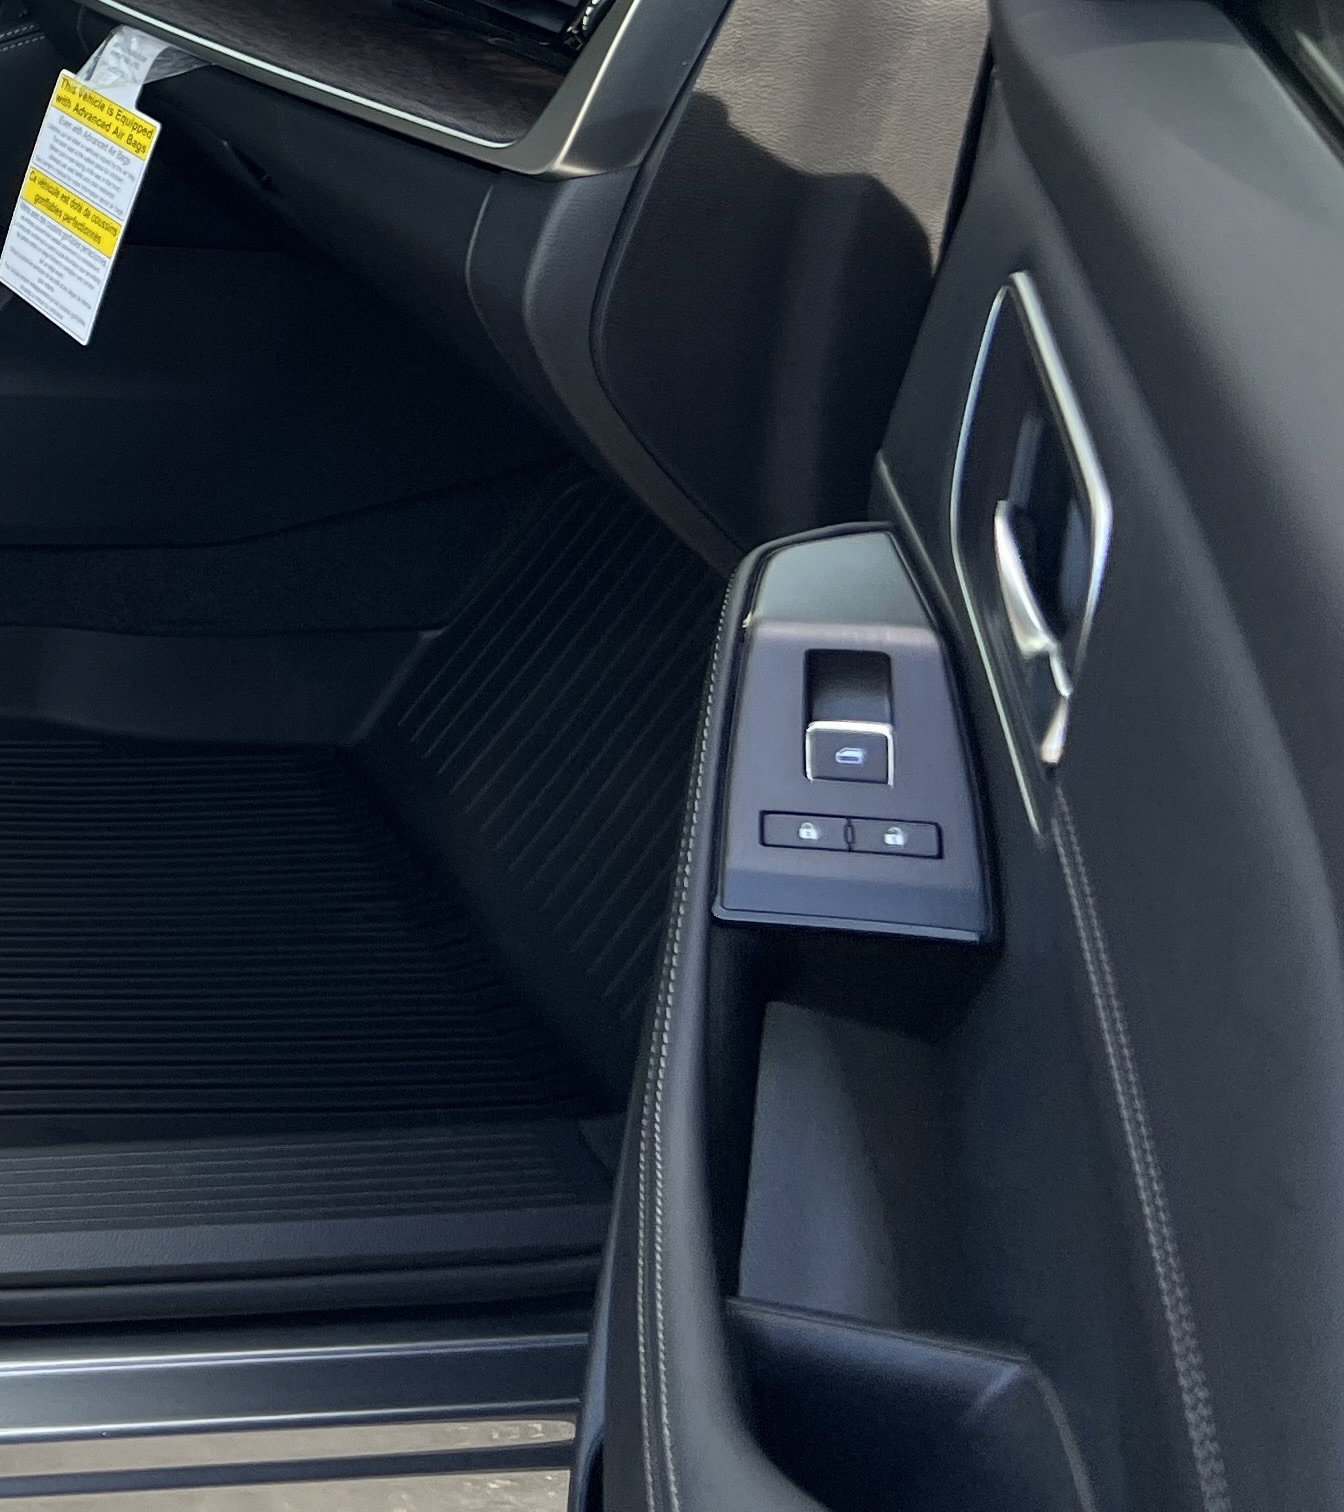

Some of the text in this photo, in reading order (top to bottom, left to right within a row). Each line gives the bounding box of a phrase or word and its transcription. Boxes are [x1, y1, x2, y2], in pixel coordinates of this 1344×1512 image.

[56, 94, 146, 154] with Advanced Air Bags
[61, 77, 154, 139] This Vehicle is Equipped
